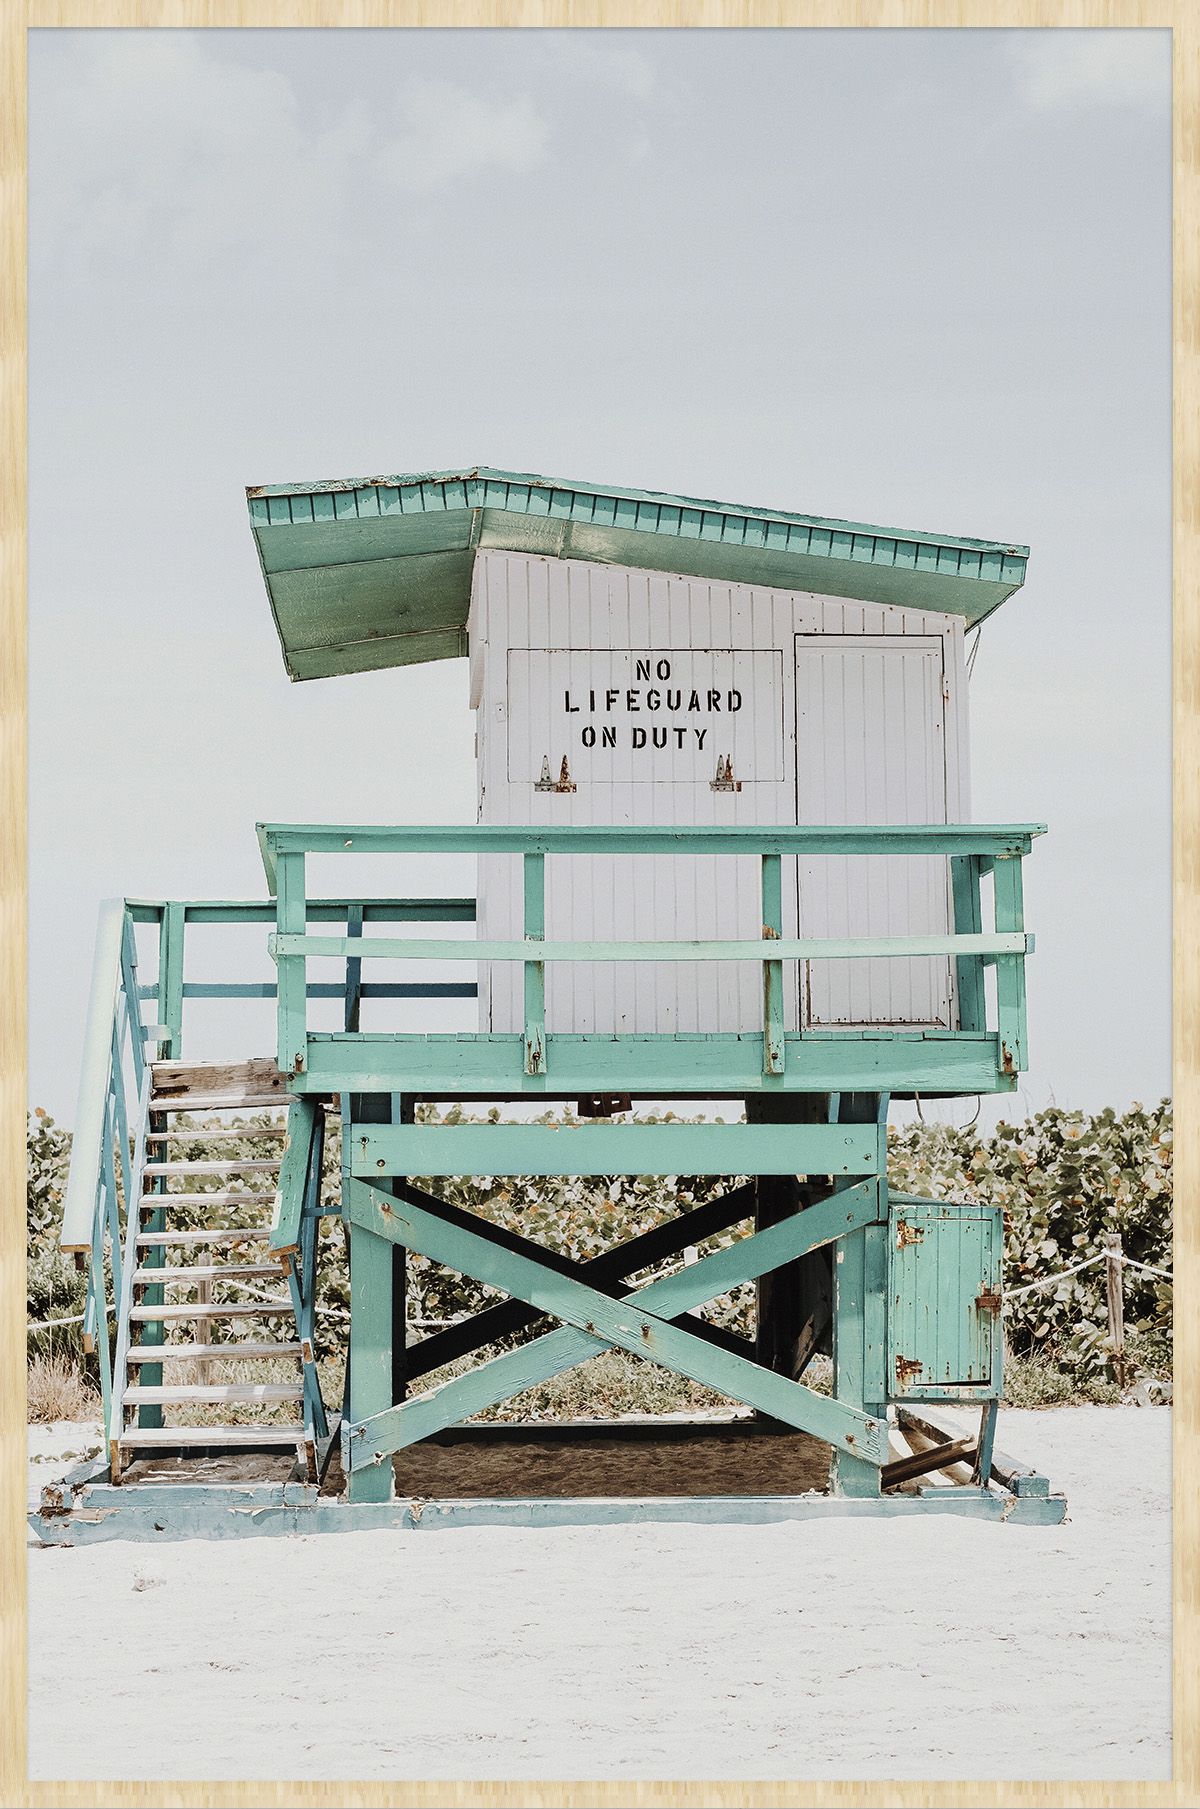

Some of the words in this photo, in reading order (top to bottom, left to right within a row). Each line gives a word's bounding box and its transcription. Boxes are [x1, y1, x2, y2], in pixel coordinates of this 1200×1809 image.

[635, 658, 671, 682] NO
[564, 687, 743, 713] LIFEGUARD
[581, 725, 617, 749] ON
[632, 727, 708, 751] DUTY
